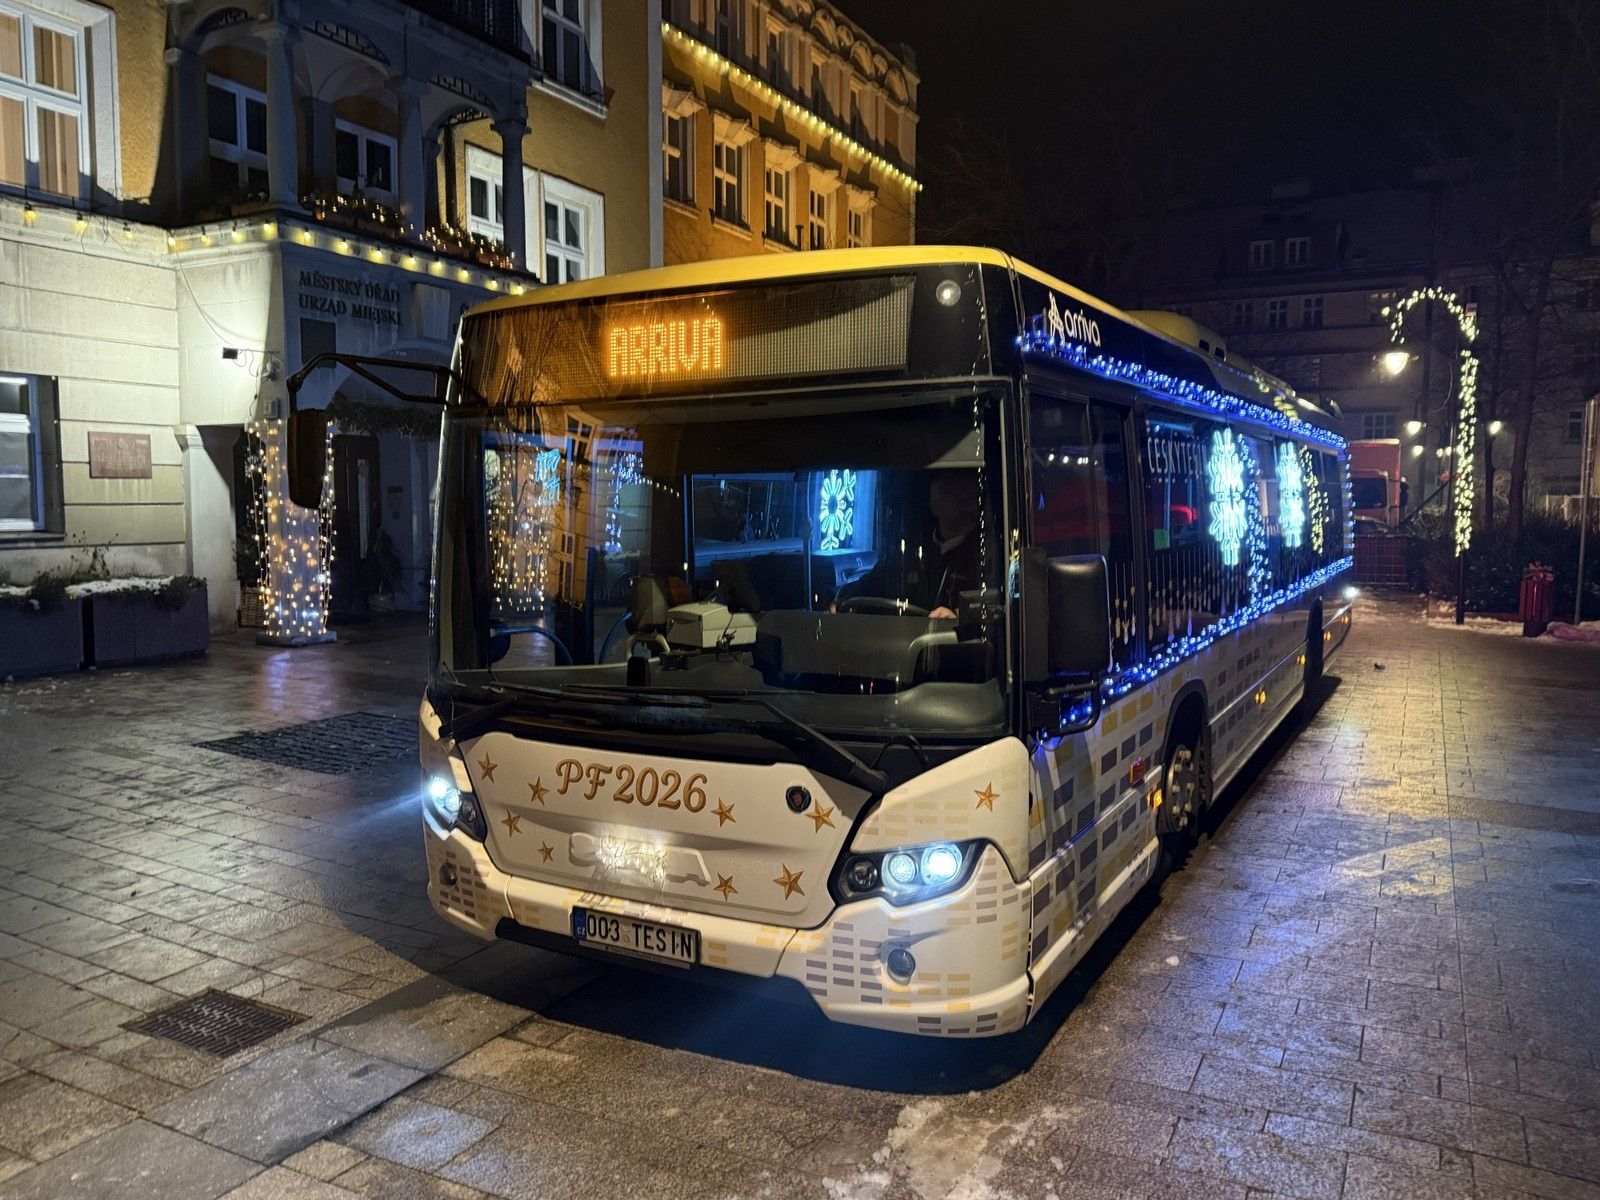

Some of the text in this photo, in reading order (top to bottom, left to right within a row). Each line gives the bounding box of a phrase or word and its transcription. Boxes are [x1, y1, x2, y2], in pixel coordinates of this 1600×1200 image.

[299, 269, 400, 302] MĚSTSKÝ ÚŘAD
[299, 294, 402, 325] URZĄD MIEJSKI
[1064, 308, 1101, 347] arriva
[609, 318, 721, 377] ARRIVA
[587, 914, 620, 942] 003
[631, 922, 692, 959] TESIN
